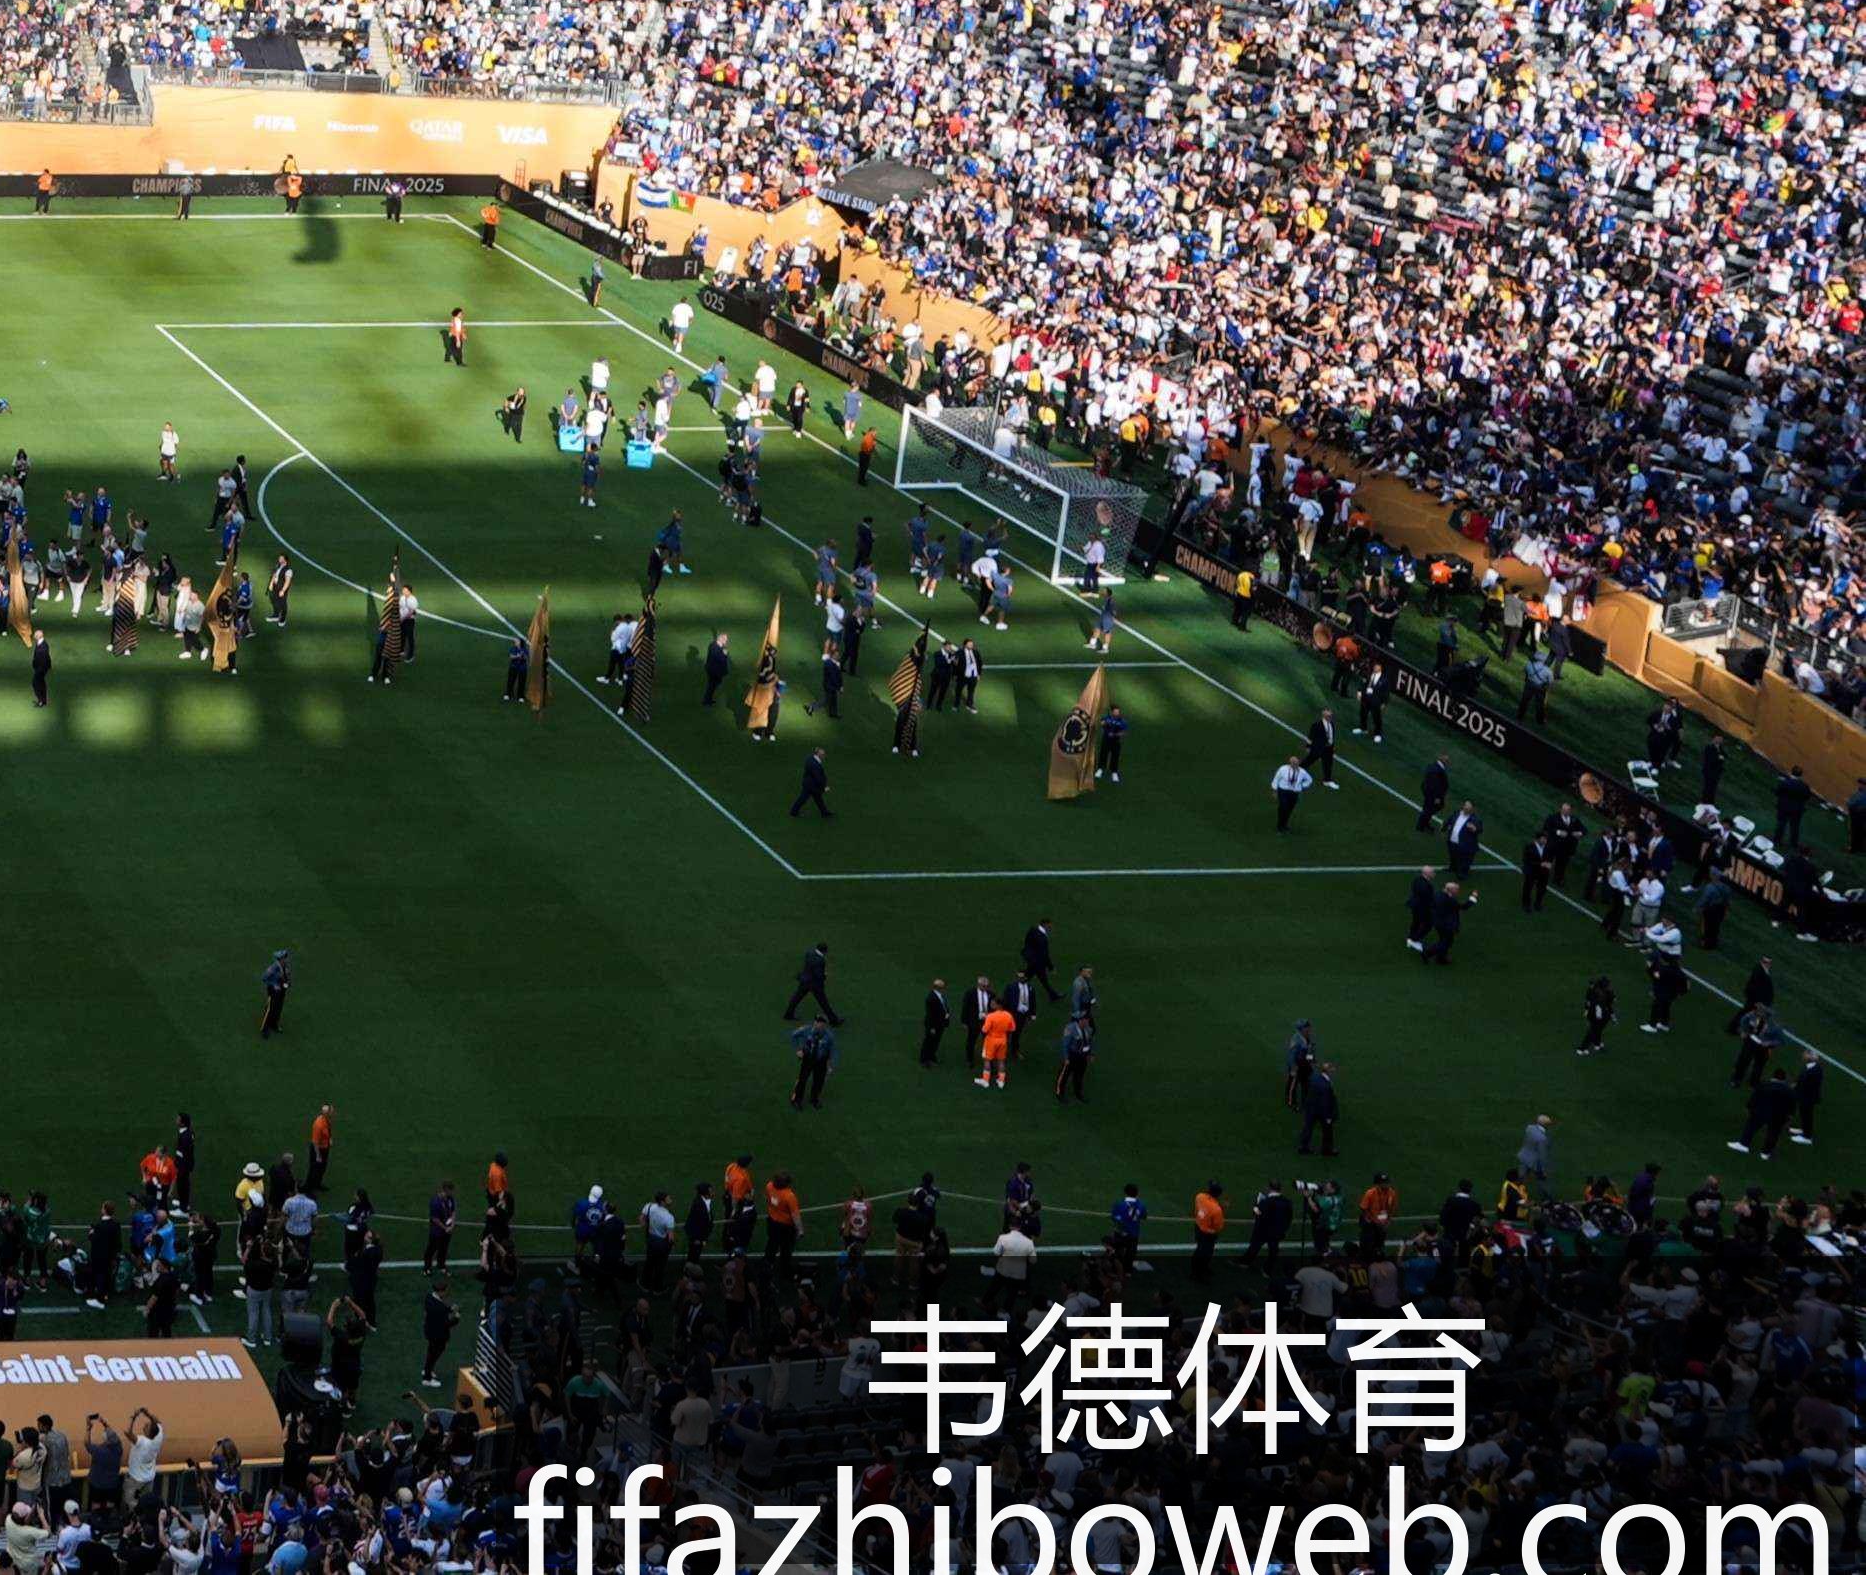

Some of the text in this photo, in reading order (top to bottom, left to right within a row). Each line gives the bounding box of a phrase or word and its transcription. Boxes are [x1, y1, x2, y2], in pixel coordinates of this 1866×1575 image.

[253, 115, 296, 132] FIFA
[496, 124, 548, 145] VISA
[353, 177, 445, 194] FINA 2025
[1175, 544, 1236, 596] CHAMPION
[1396, 669, 1507, 749] FINAL 2025
